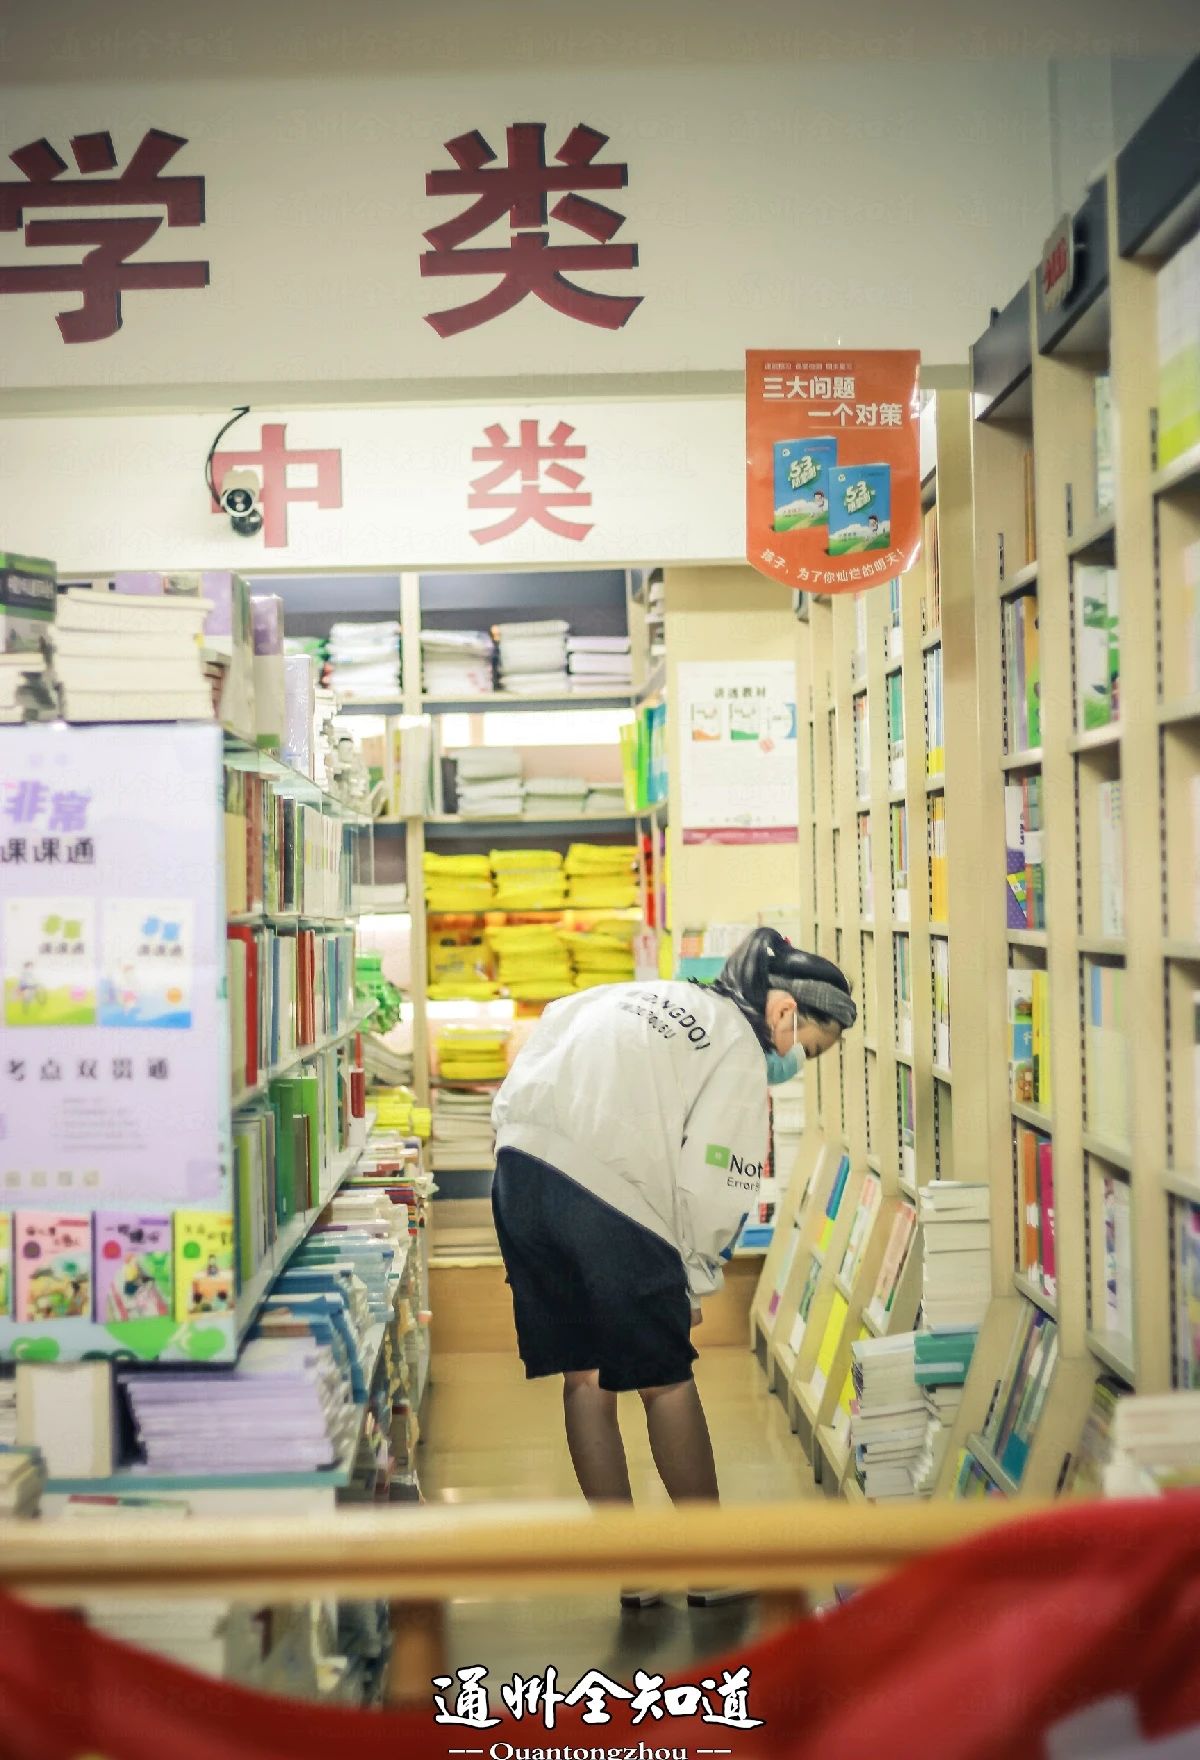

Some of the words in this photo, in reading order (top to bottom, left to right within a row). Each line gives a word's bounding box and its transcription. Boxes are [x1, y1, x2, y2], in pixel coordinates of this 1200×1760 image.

[0, 128, 210, 344] 学
[420, 122, 645, 338] 类
[762, 375, 856, 399] 三大问题
[808, 402, 903, 427] 一个对策
[210, 422, 343, 548] 中
[467, 419, 594, 546] 类
